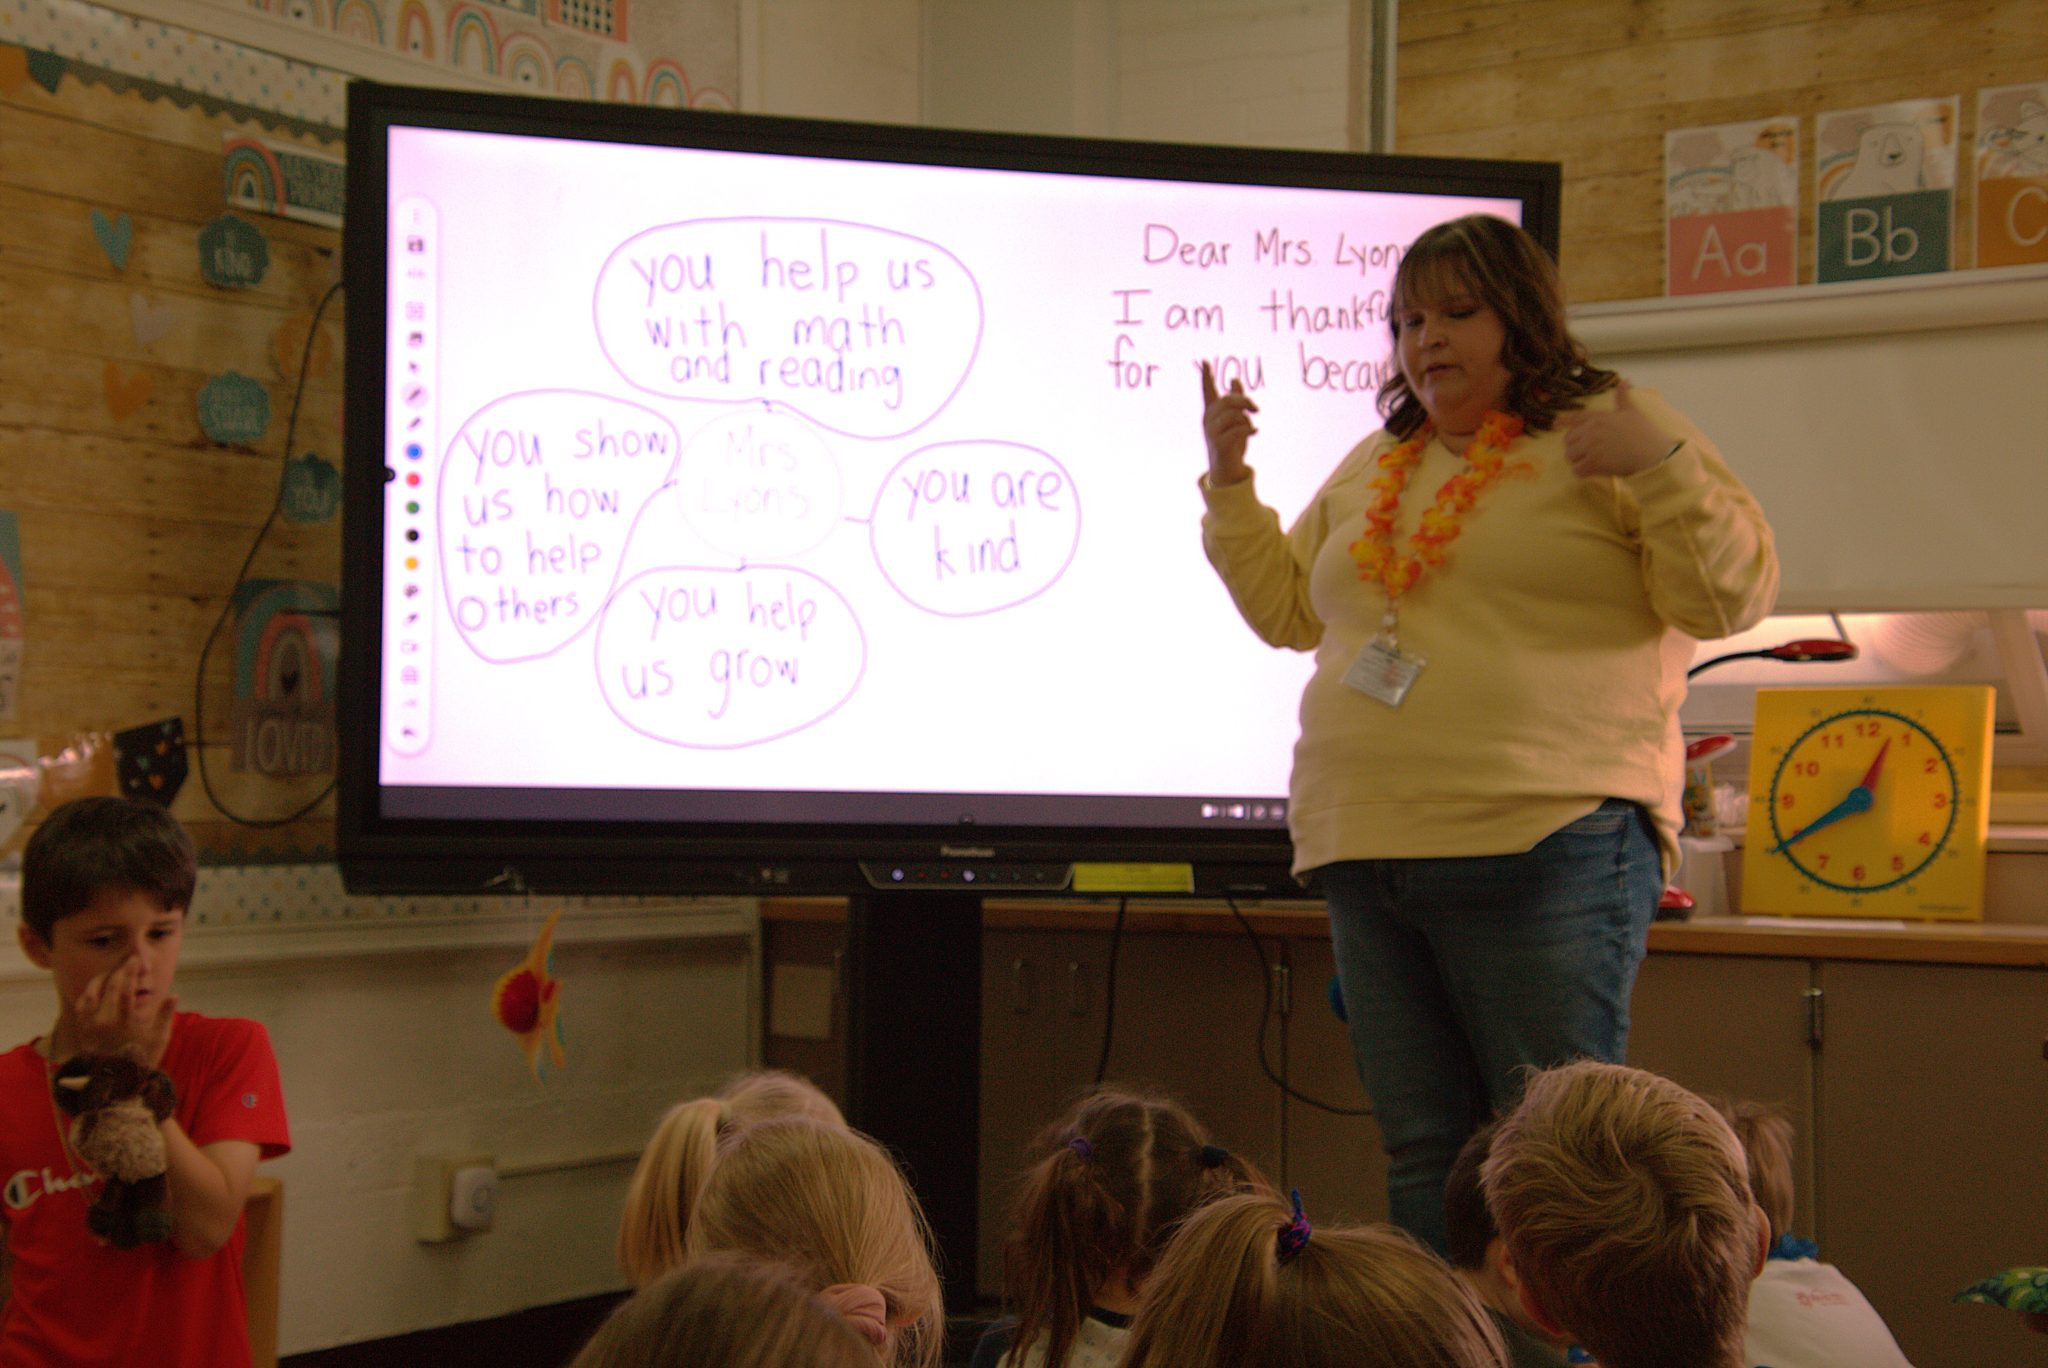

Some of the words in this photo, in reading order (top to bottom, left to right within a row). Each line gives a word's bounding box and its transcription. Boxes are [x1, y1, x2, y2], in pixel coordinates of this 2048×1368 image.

[1143, 222, 1232, 269] Dear
[1335, 231, 1409, 277] Lyon
[1690, 223, 1769, 281] Aa
[1843, 205, 1920, 267] Bb
[630, 253, 715, 307] you
[760, 228, 859, 304] help
[886, 258, 936, 290] us
[645, 300, 747, 348] with
[793, 303, 906, 352] math
[1111, 288, 1153, 326] I
[1164, 303, 1225, 333] am
[1259, 288, 1390, 333] thankfu
[670, 349, 731, 384] and
[758, 347, 903, 411] reading
[1107, 333, 1161, 389] for
[1298, 340, 1389, 392] becau
[461, 428, 542, 485] you
[573, 417, 669, 459] show
[726, 424, 798, 471] Mrs
[463, 488, 514, 527] us
[544, 471, 620, 519] how
[701, 478, 812, 524] Lyons
[902, 469, 970, 522] you
[991, 470, 1062, 511] are
[456, 533, 503, 576] to
[525, 528, 602, 575] help
[933, 518, 1022, 581] kind
[639, 585, 719, 641] you
[746, 580, 818, 641] help
[621, 659, 674, 699] us
[707, 647, 799, 720] grow
[1821, 734, 1845, 749] 11
[1855, 721, 1882, 739] 12
[1901, 732, 1913, 748] 1
[1794, 761, 1820, 777] 10
[1924, 757, 1939, 774] 2
[1781, 793, 1795, 810] 9
[1934, 793, 1947, 809] 3
[1817, 853, 1830, 870] 7
[1917, 831, 1931, 846] 4
[1852, 865, 1865, 881] 6
[1891, 855, 1904, 872] 5
[3, 1166, 97, 1210] Cha
